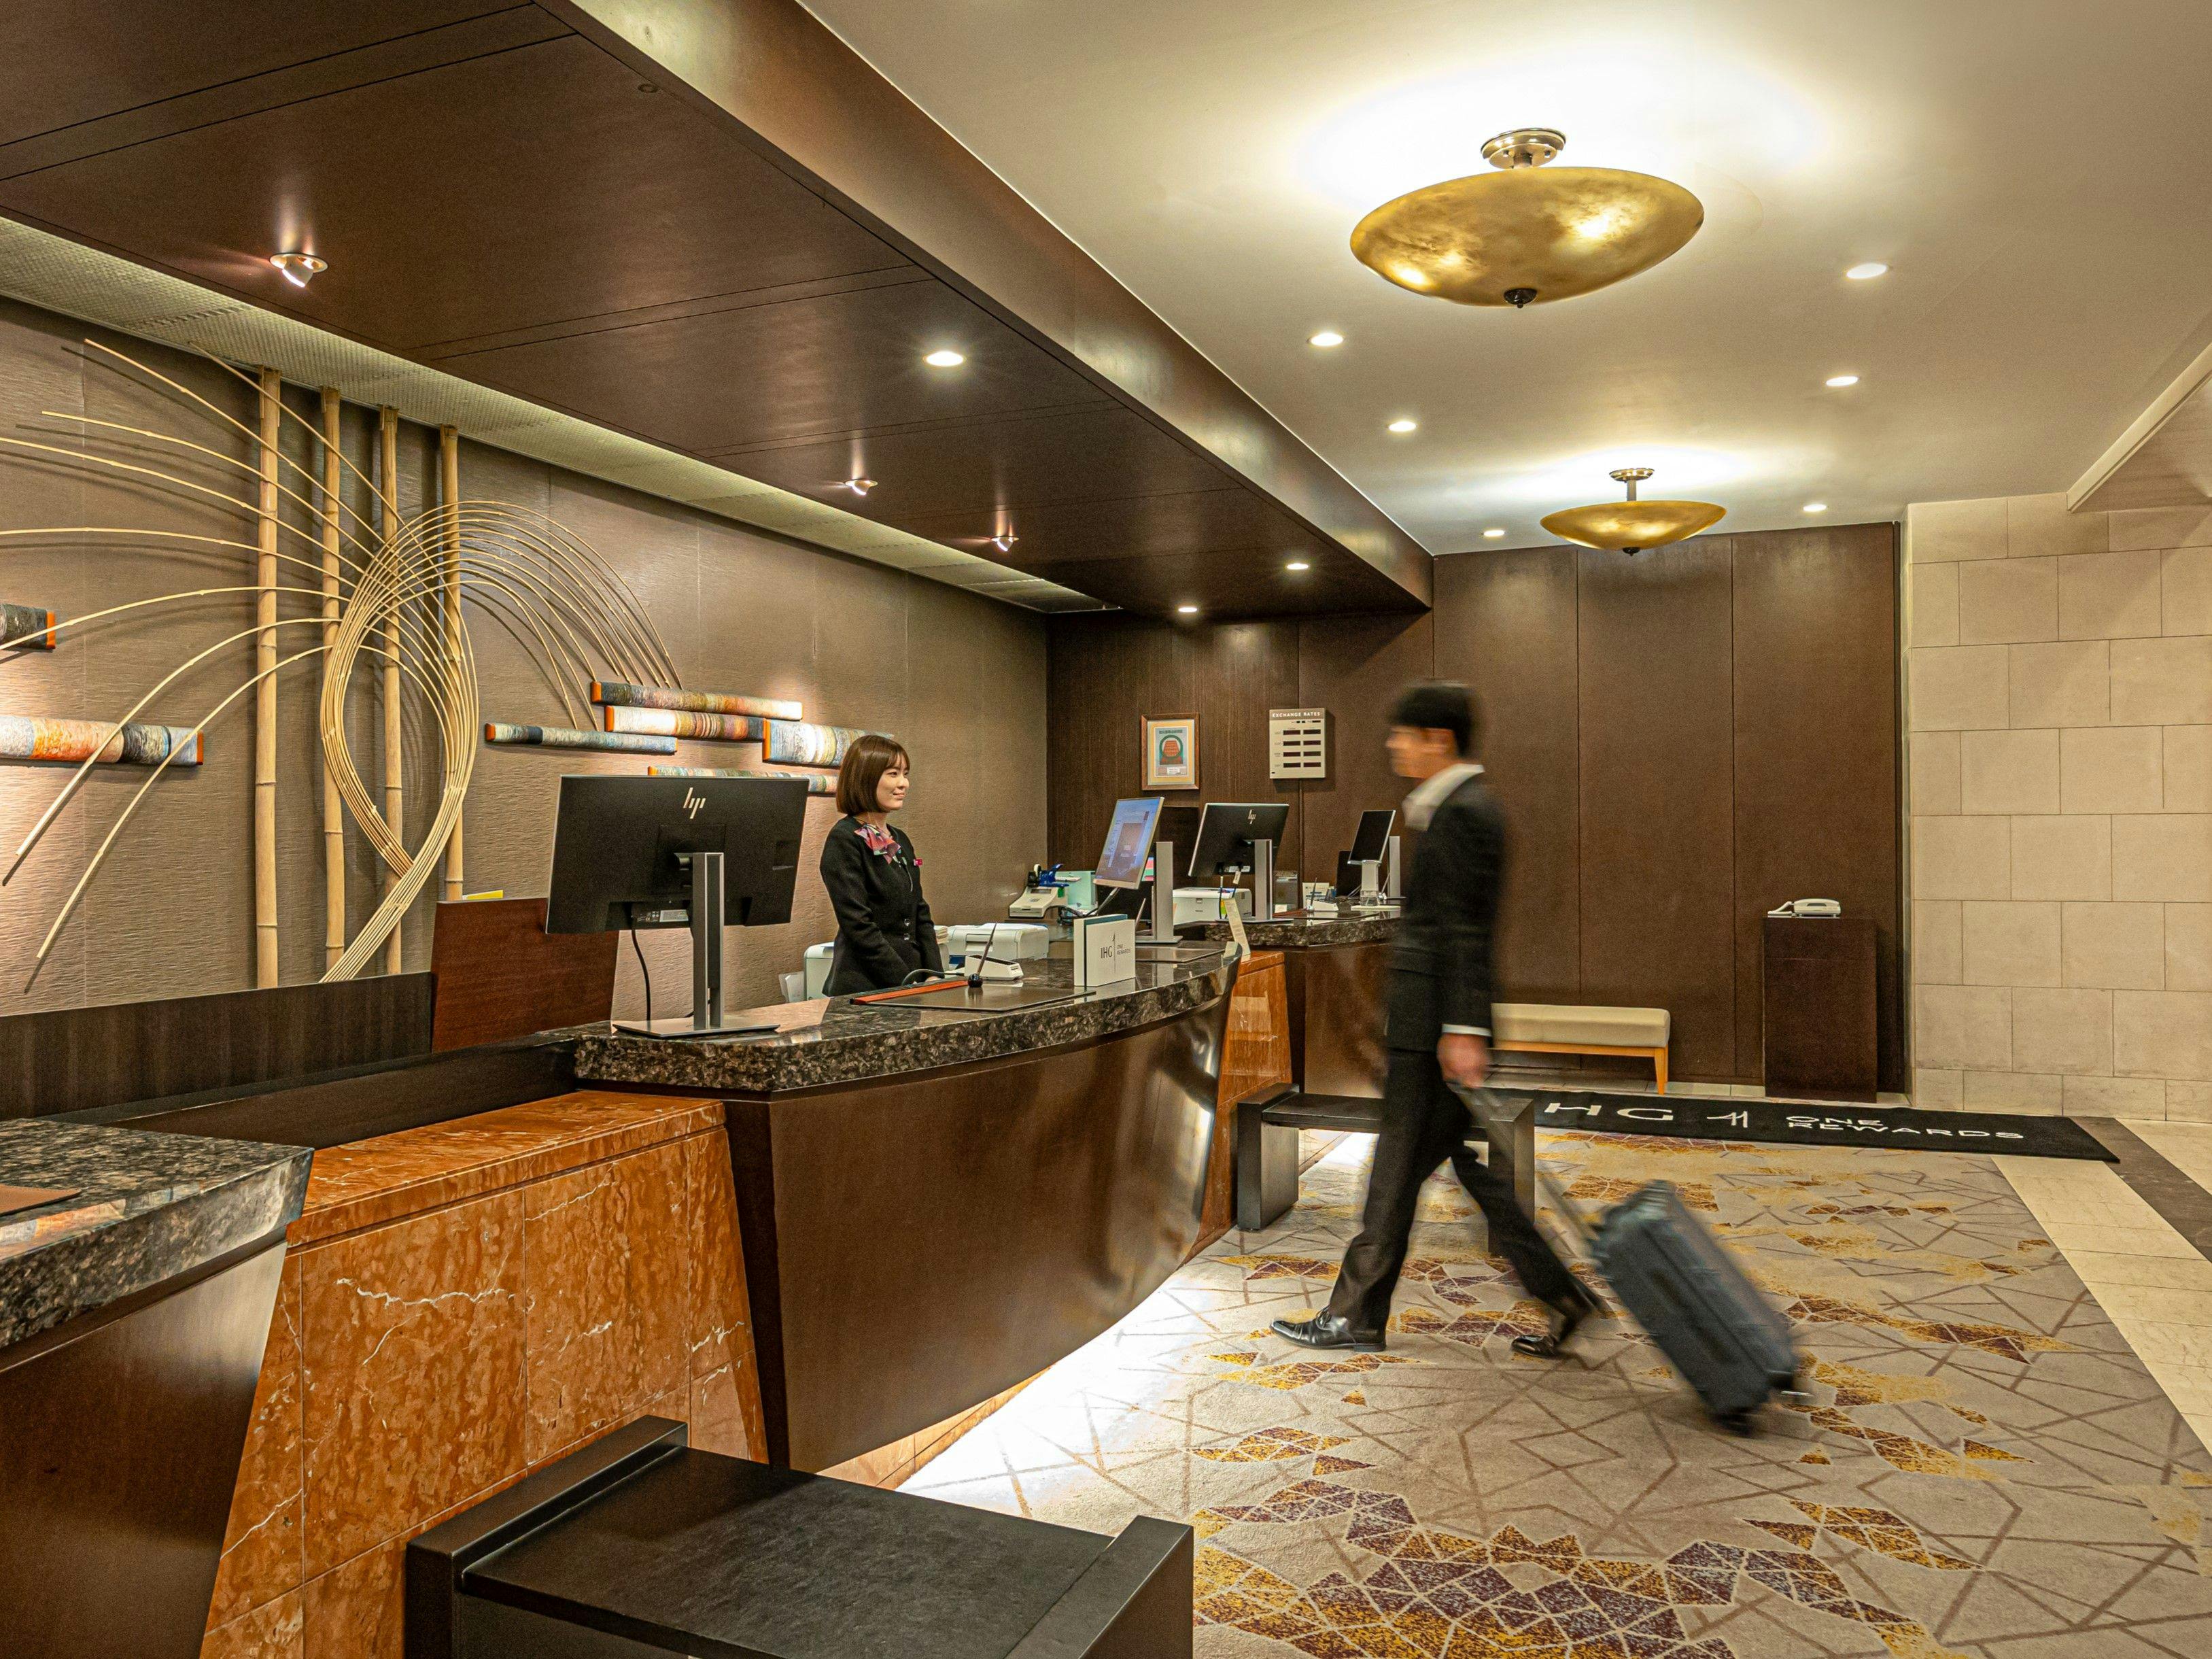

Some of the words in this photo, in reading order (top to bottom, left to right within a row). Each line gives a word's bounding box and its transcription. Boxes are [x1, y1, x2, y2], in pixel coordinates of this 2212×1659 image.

[683, 787, 706, 819] hp
[1101, 946, 1113, 959] IHG
[1544, 1102, 1674, 1121] HG
[1786, 1116, 1883, 1126] ONE
[1788, 1122, 2024, 1139] REWARDS
